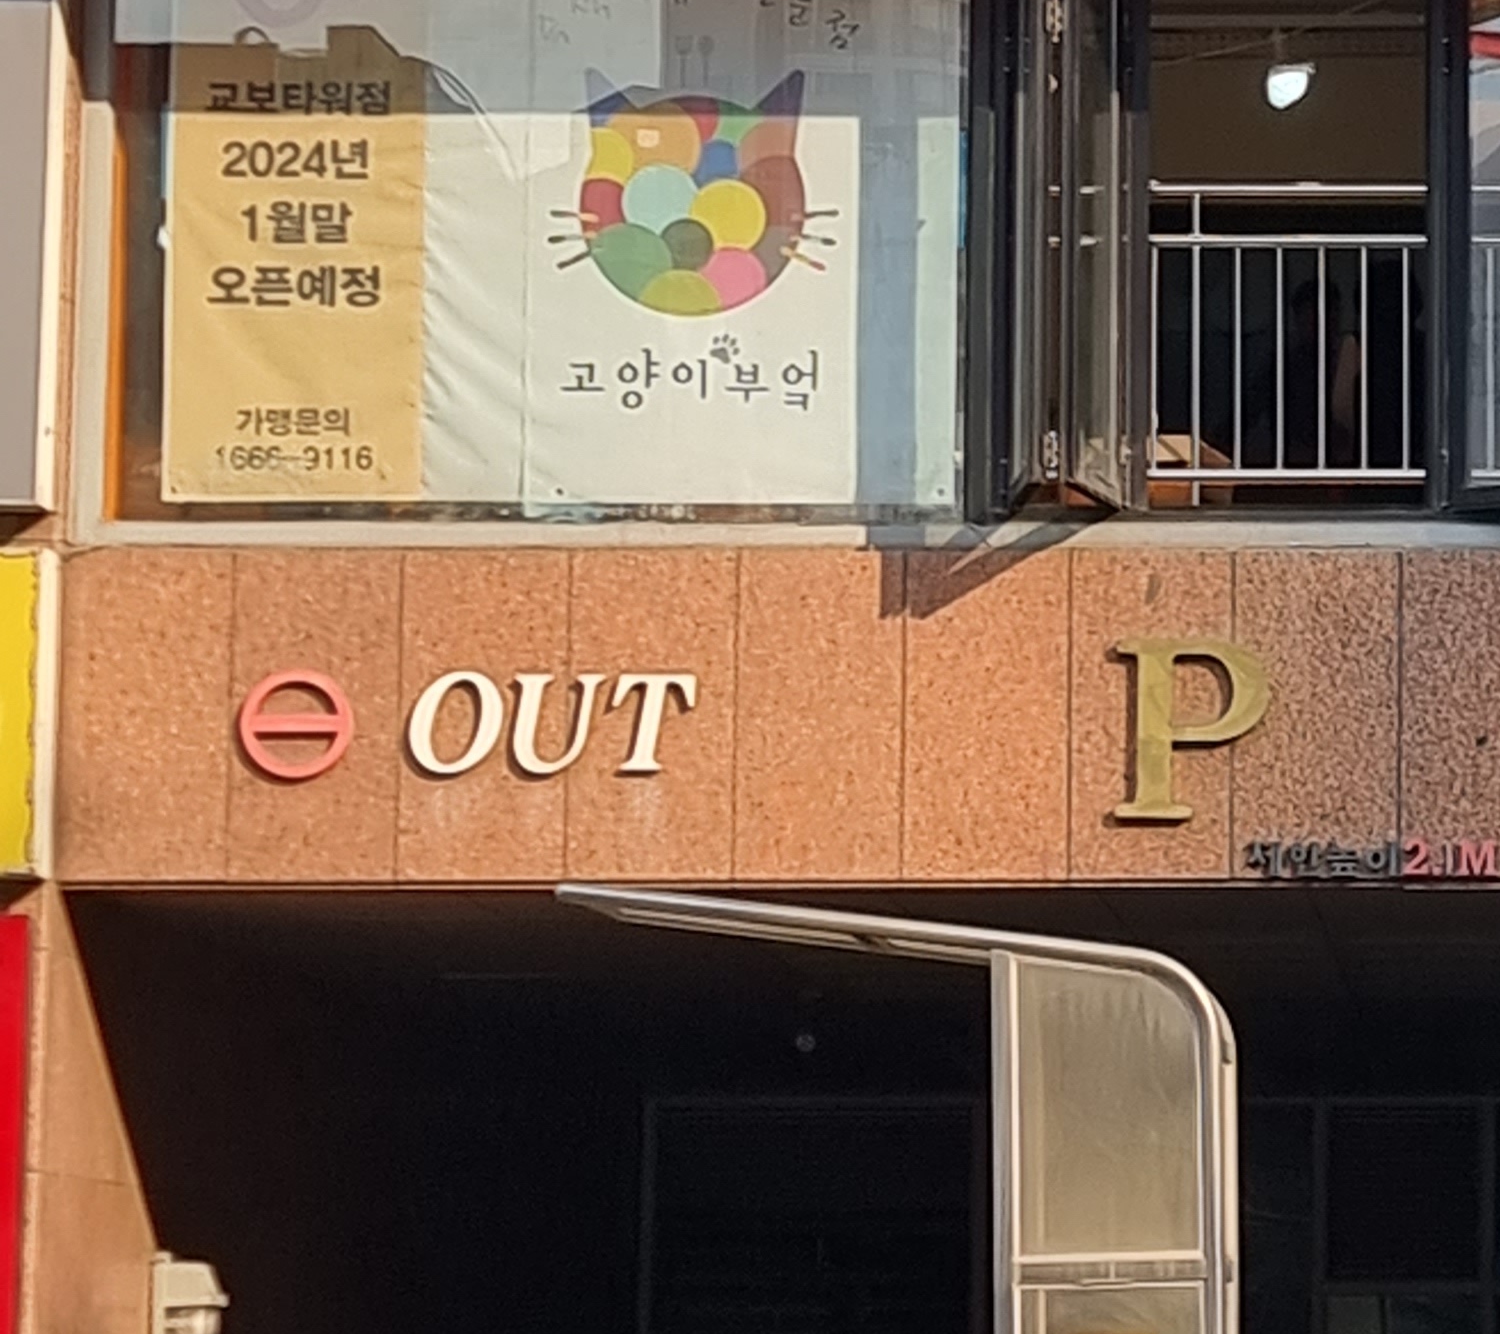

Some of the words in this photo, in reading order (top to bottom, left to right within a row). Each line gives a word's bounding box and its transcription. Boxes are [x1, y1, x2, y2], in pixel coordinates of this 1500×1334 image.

[205, 81, 391, 116] 교보타워점
[221, 138, 369, 180] 2024년
[206, 265, 381, 308] 오픈예정
[236, 406, 350, 436] 가맹문의
[406, 670, 697, 776] OUT
[1115, 638, 1271, 821] P
